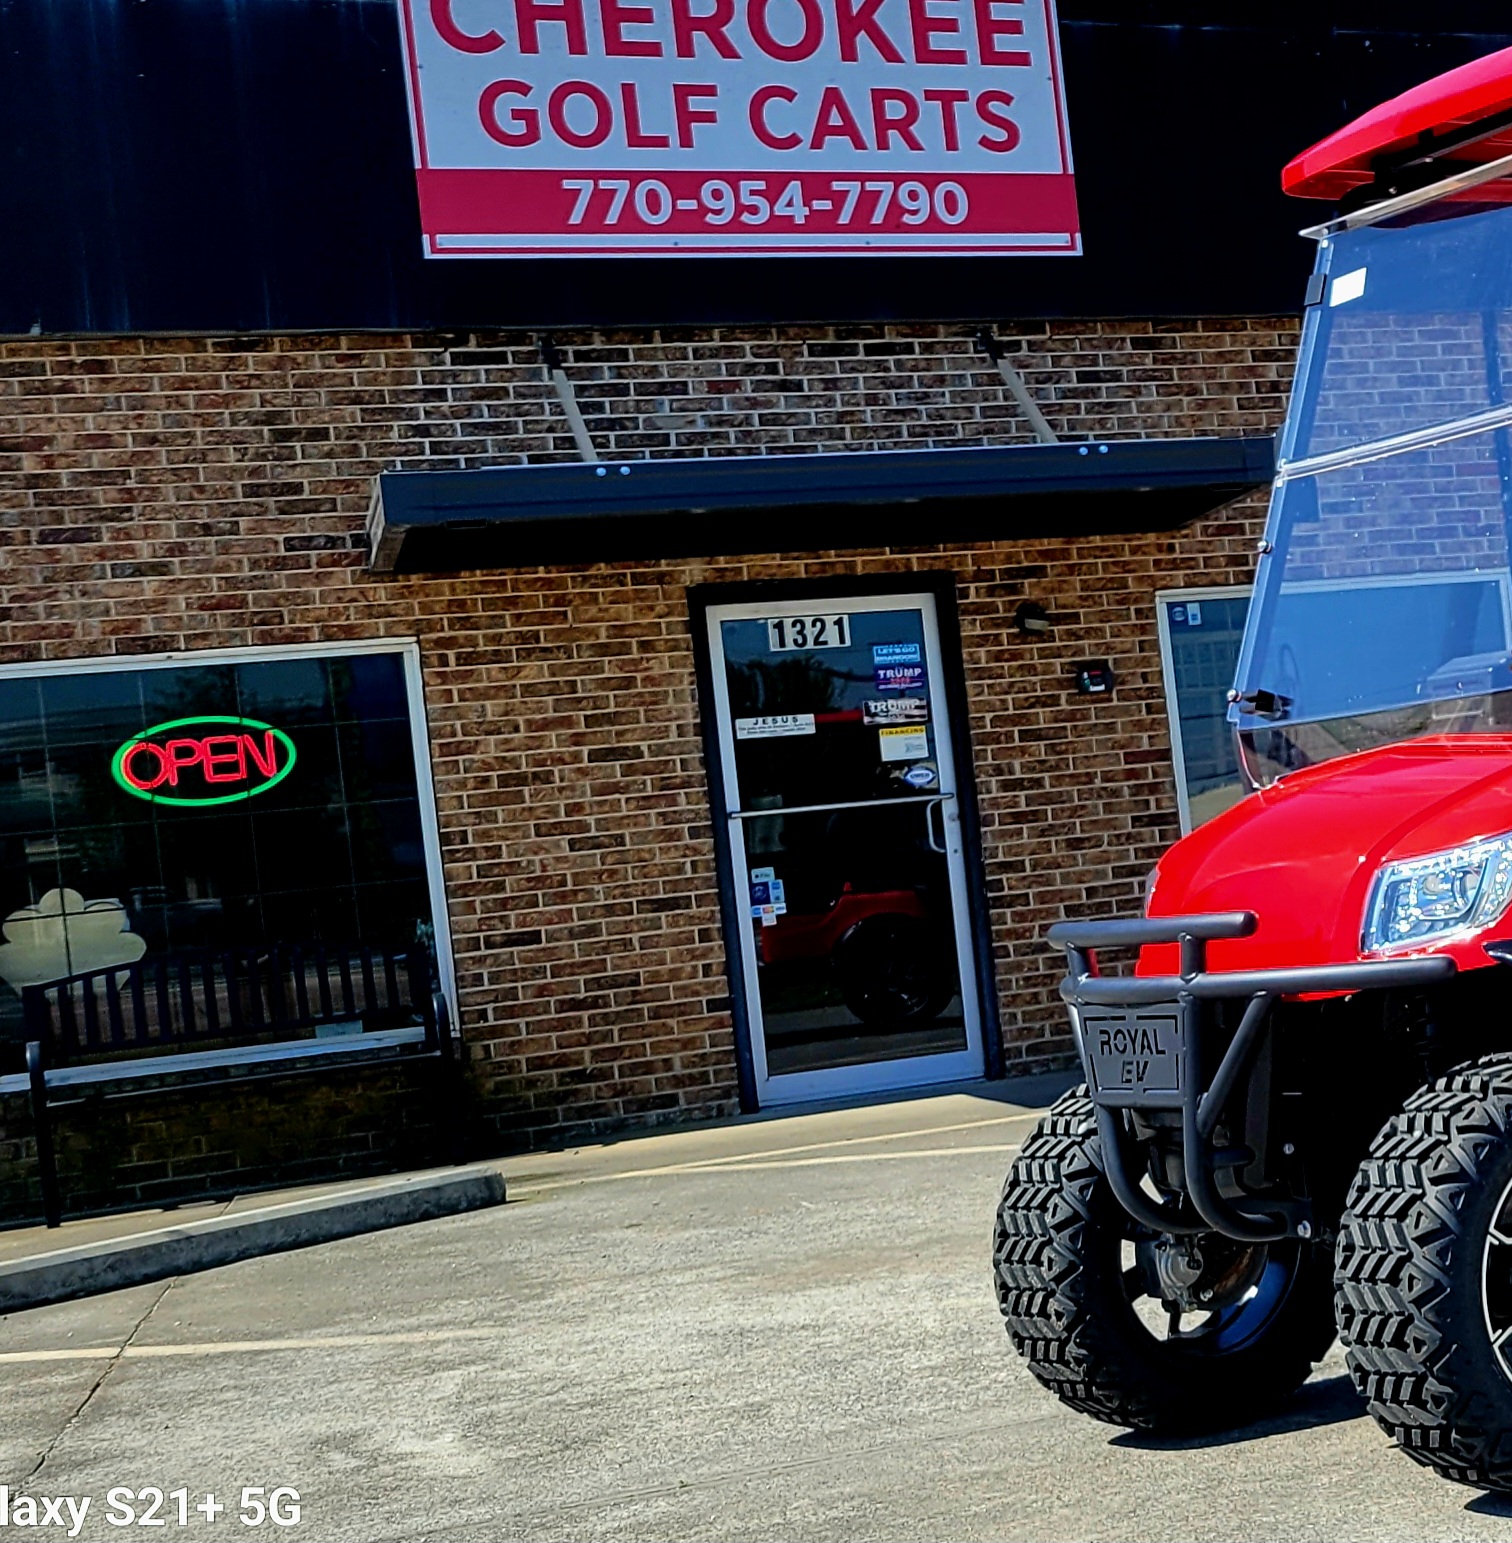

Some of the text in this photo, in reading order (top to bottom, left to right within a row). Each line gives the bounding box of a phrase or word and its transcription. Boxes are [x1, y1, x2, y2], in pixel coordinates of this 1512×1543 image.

[431, 0, 1033, 67] CHEROKEE
[478, 79, 1021, 153] GOLF CARTS
[561, 178, 969, 225] 770-954-7790
[772, 616, 847, 648] 1321
[877, 666, 922, 679] TRUMP
[753, 716, 798, 725] JESUS
[121, 730, 277, 790] OPEN
[1099, 1028, 1167, 1055] ROYAL
[1121, 1060, 1149, 1084] EV
